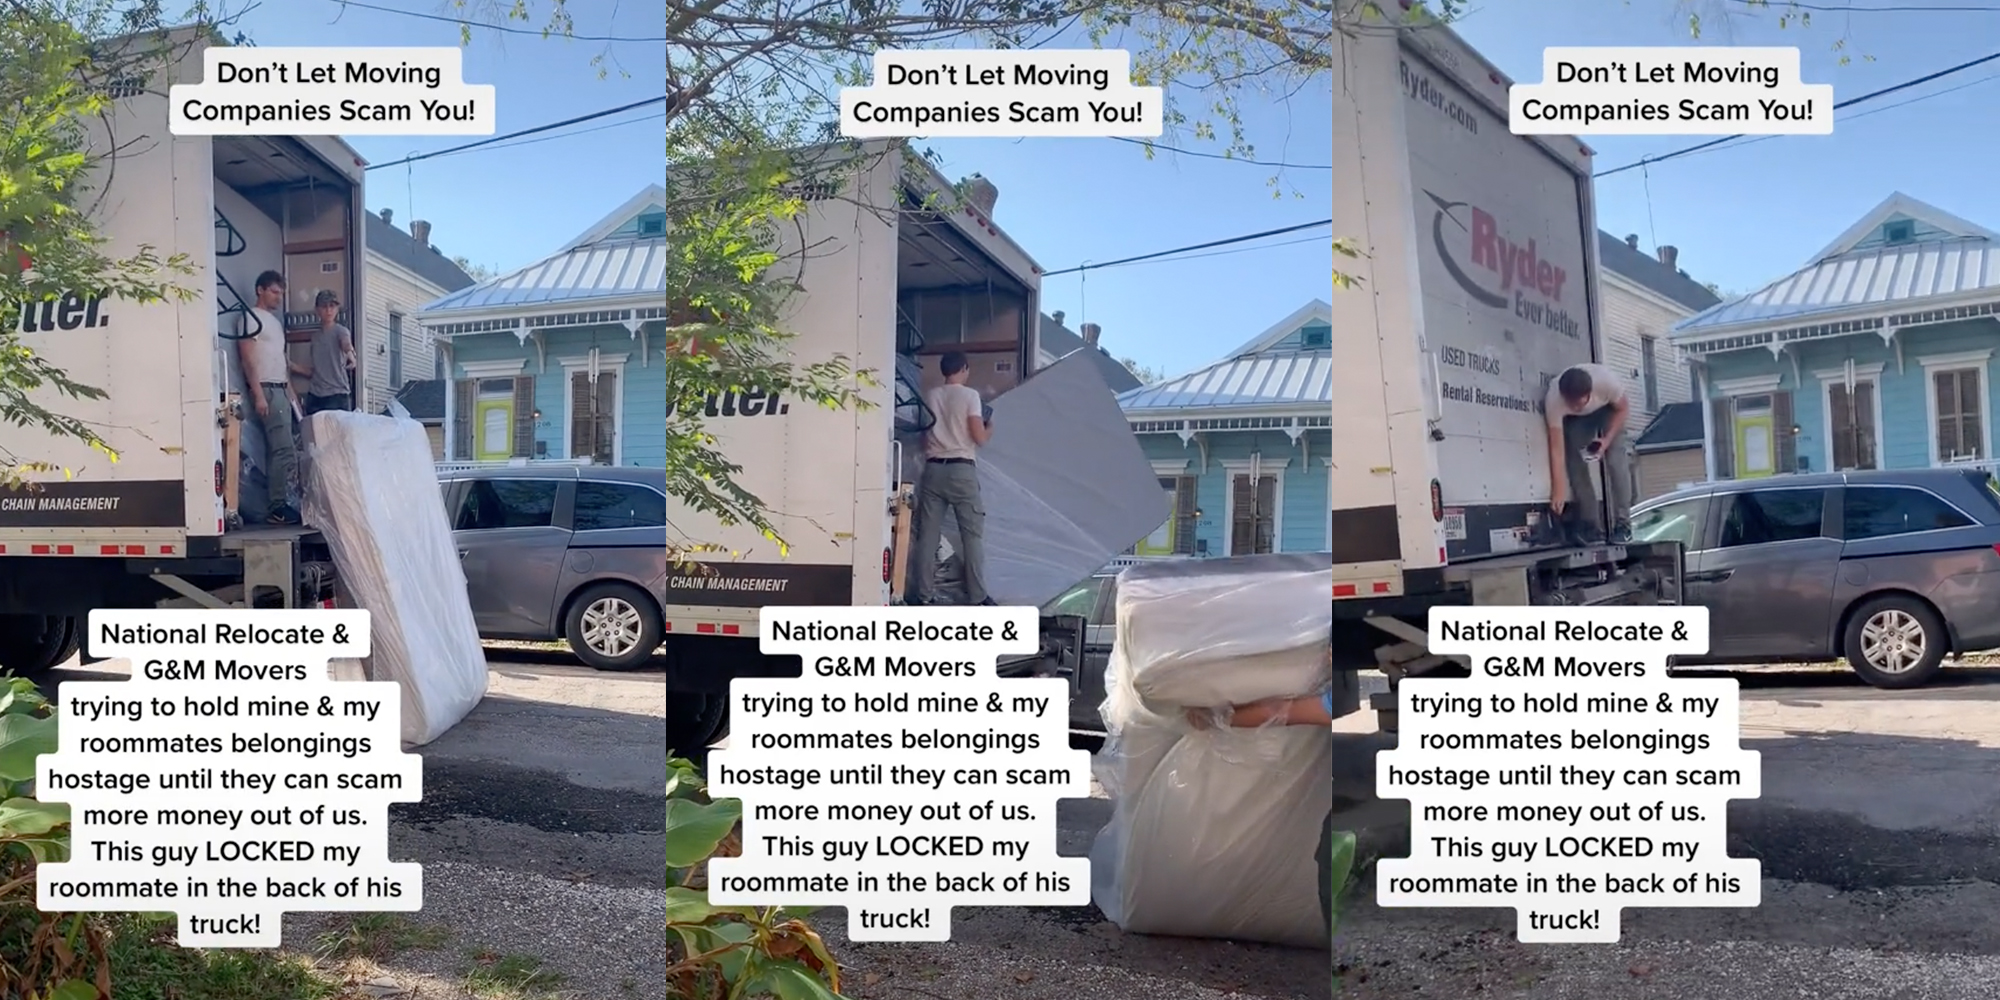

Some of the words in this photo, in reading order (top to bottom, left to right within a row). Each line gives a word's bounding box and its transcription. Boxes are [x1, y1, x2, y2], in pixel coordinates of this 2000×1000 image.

[1400, 60, 1478, 134] Ryder.com
[1471, 206, 1567, 302] Ryder
[1515, 289, 1543, 325] Ever
[1545, 305, 1581, 341] better.
[1441, 345, 1466, 368] USED
[1468, 352, 1500, 375] TRUCKS
[1442, 382, 1473, 403] Rental
[1475, 388, 1530, 412] Reservations:
[1, 498, 36, 511] CHAIN
[38, 497, 120, 511] MANAGEMENT
[670, 576, 705, 589] CHAIN
[707, 577, 788, 592] MANAGEMENT
